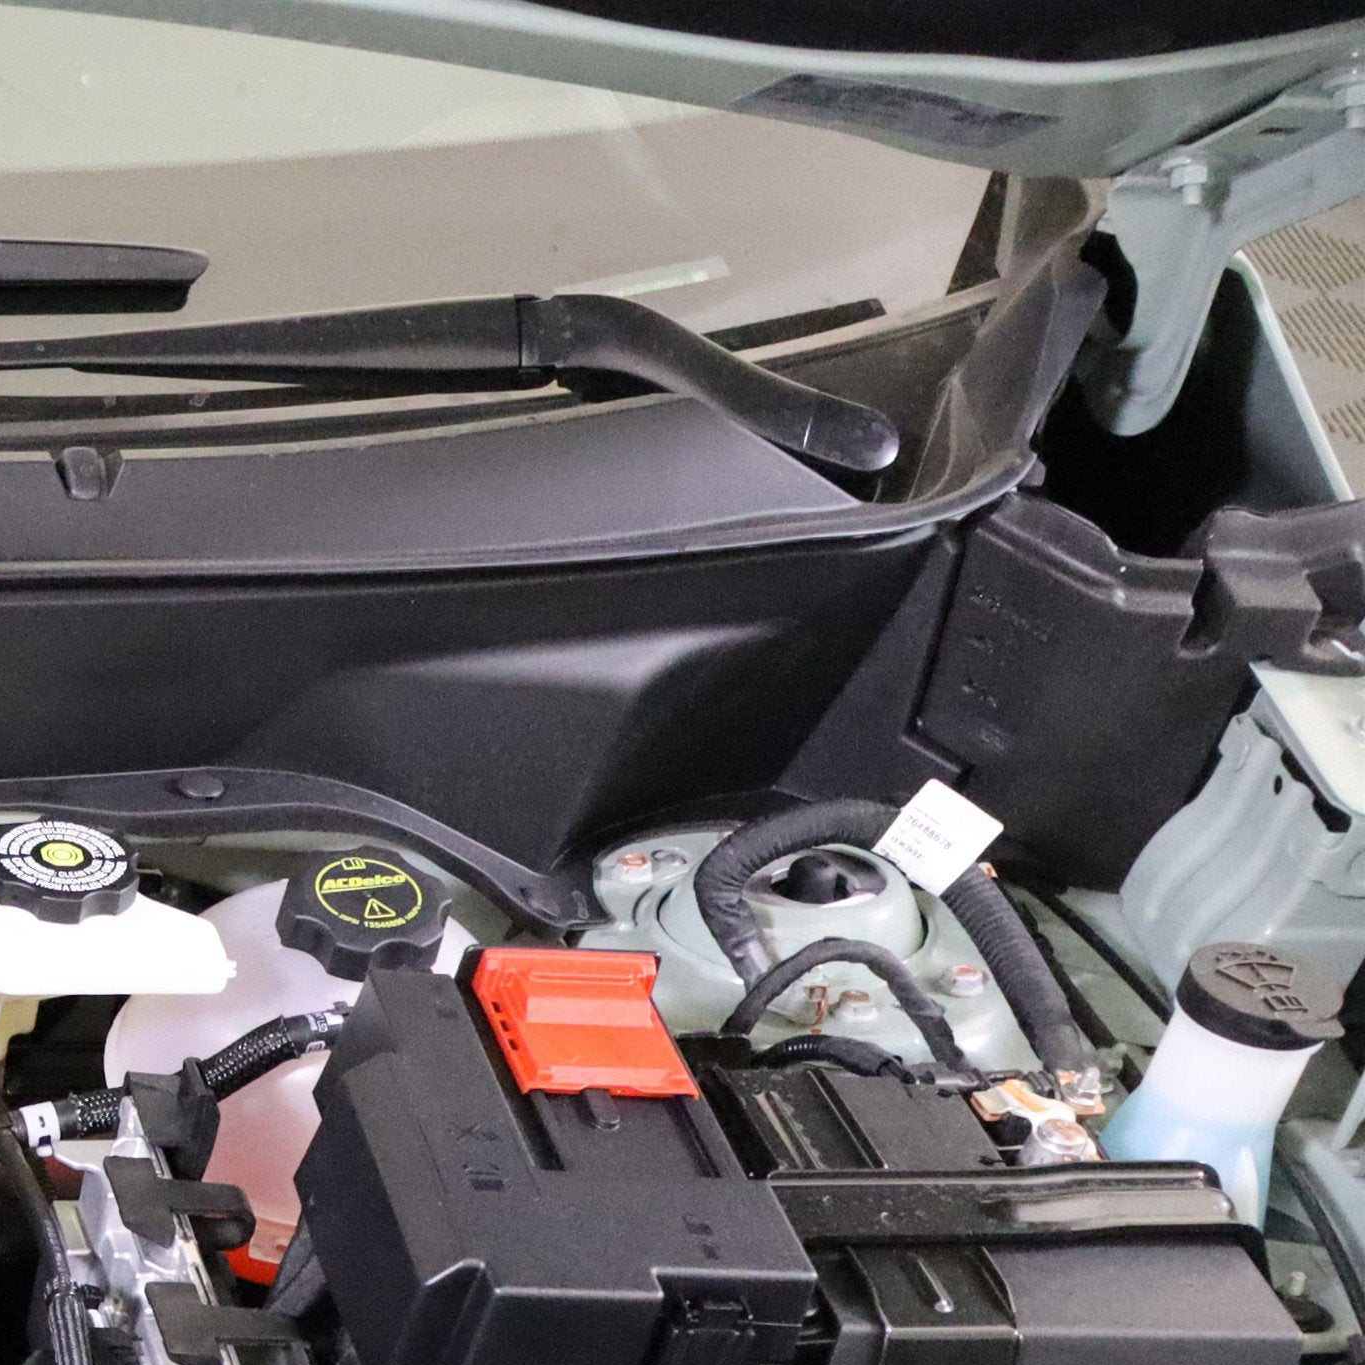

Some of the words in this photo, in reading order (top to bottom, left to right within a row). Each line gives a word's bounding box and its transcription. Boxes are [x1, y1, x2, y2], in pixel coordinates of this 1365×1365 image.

[57, 870, 88, 878] CLEAN
[34, 879, 61, 890] FROM
[321, 874, 407, 890] ACDelco
